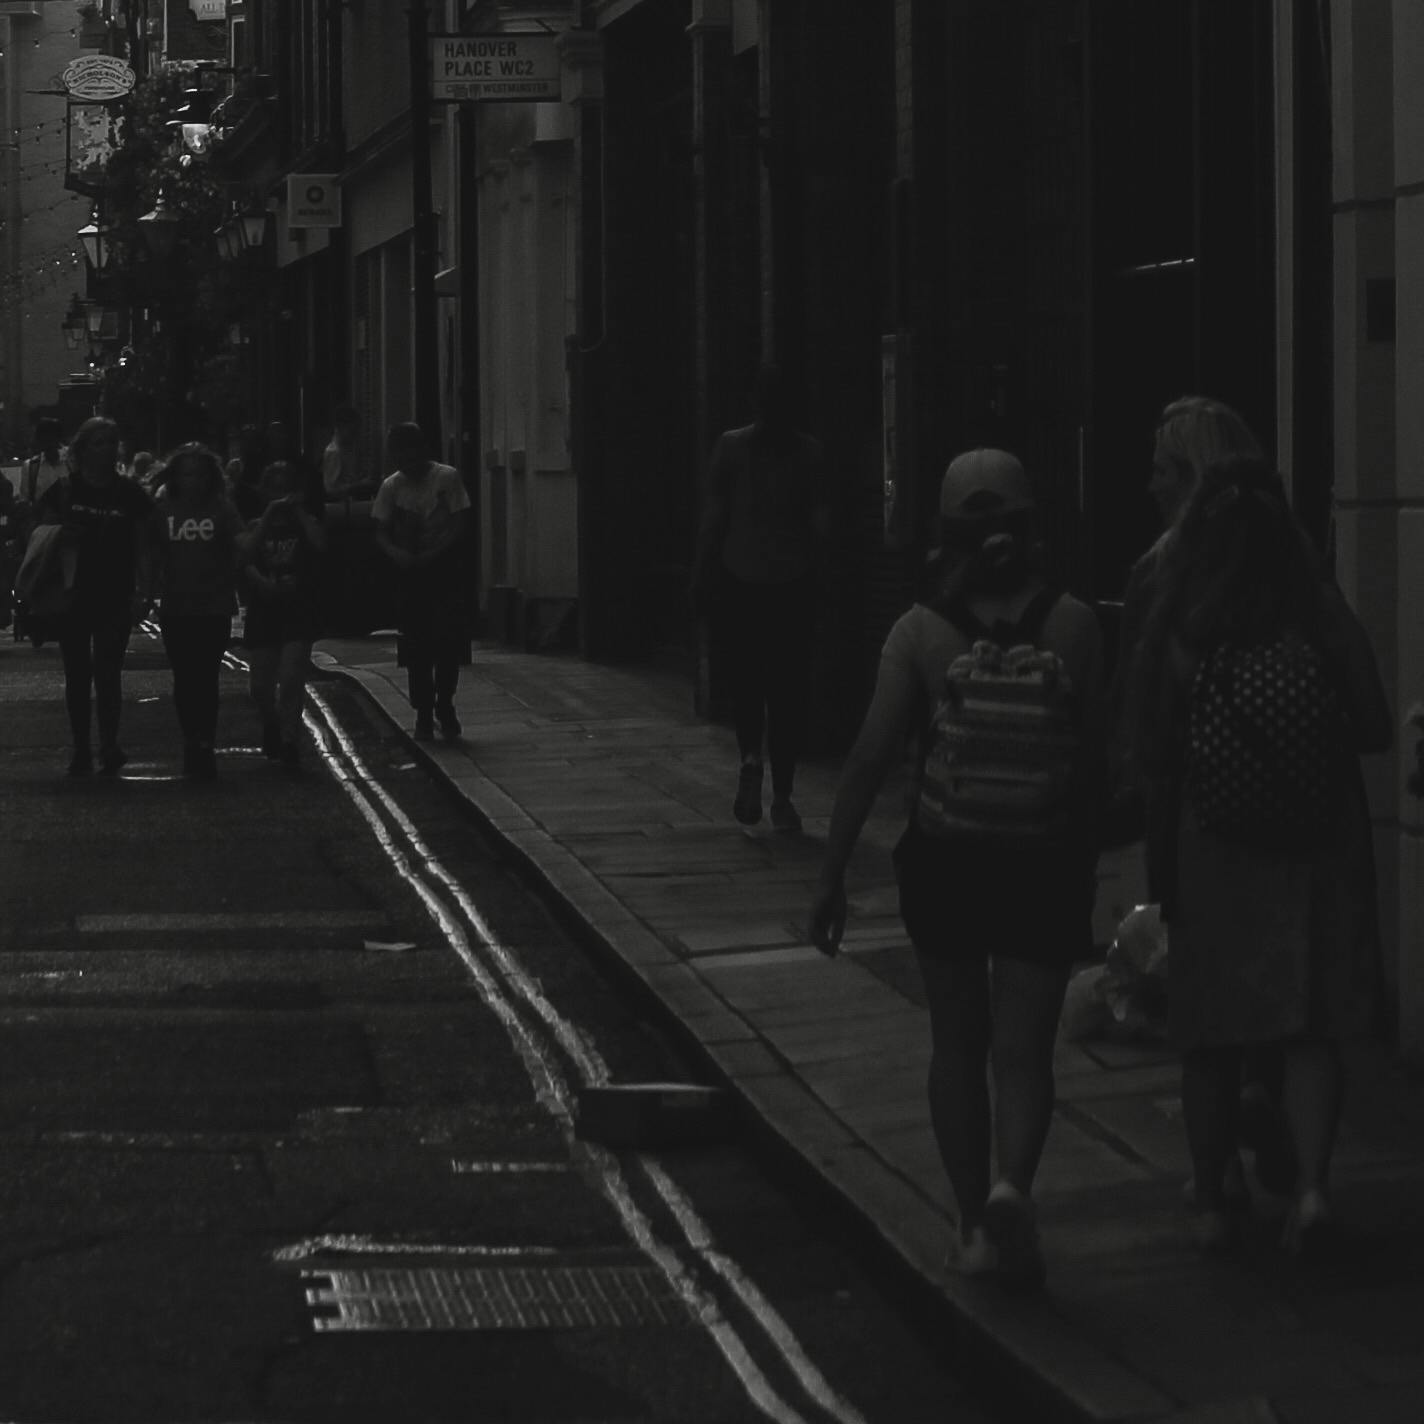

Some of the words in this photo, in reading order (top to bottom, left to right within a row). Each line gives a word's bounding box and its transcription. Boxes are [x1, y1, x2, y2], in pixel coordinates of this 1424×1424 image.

[444, 41, 517, 58] HANOVER
[444, 60, 492, 76] PLACE
[500, 60, 534, 75] WC2
[483, 82, 549, 93] WESTMINSTER
[167, 515, 215, 542] Lee
